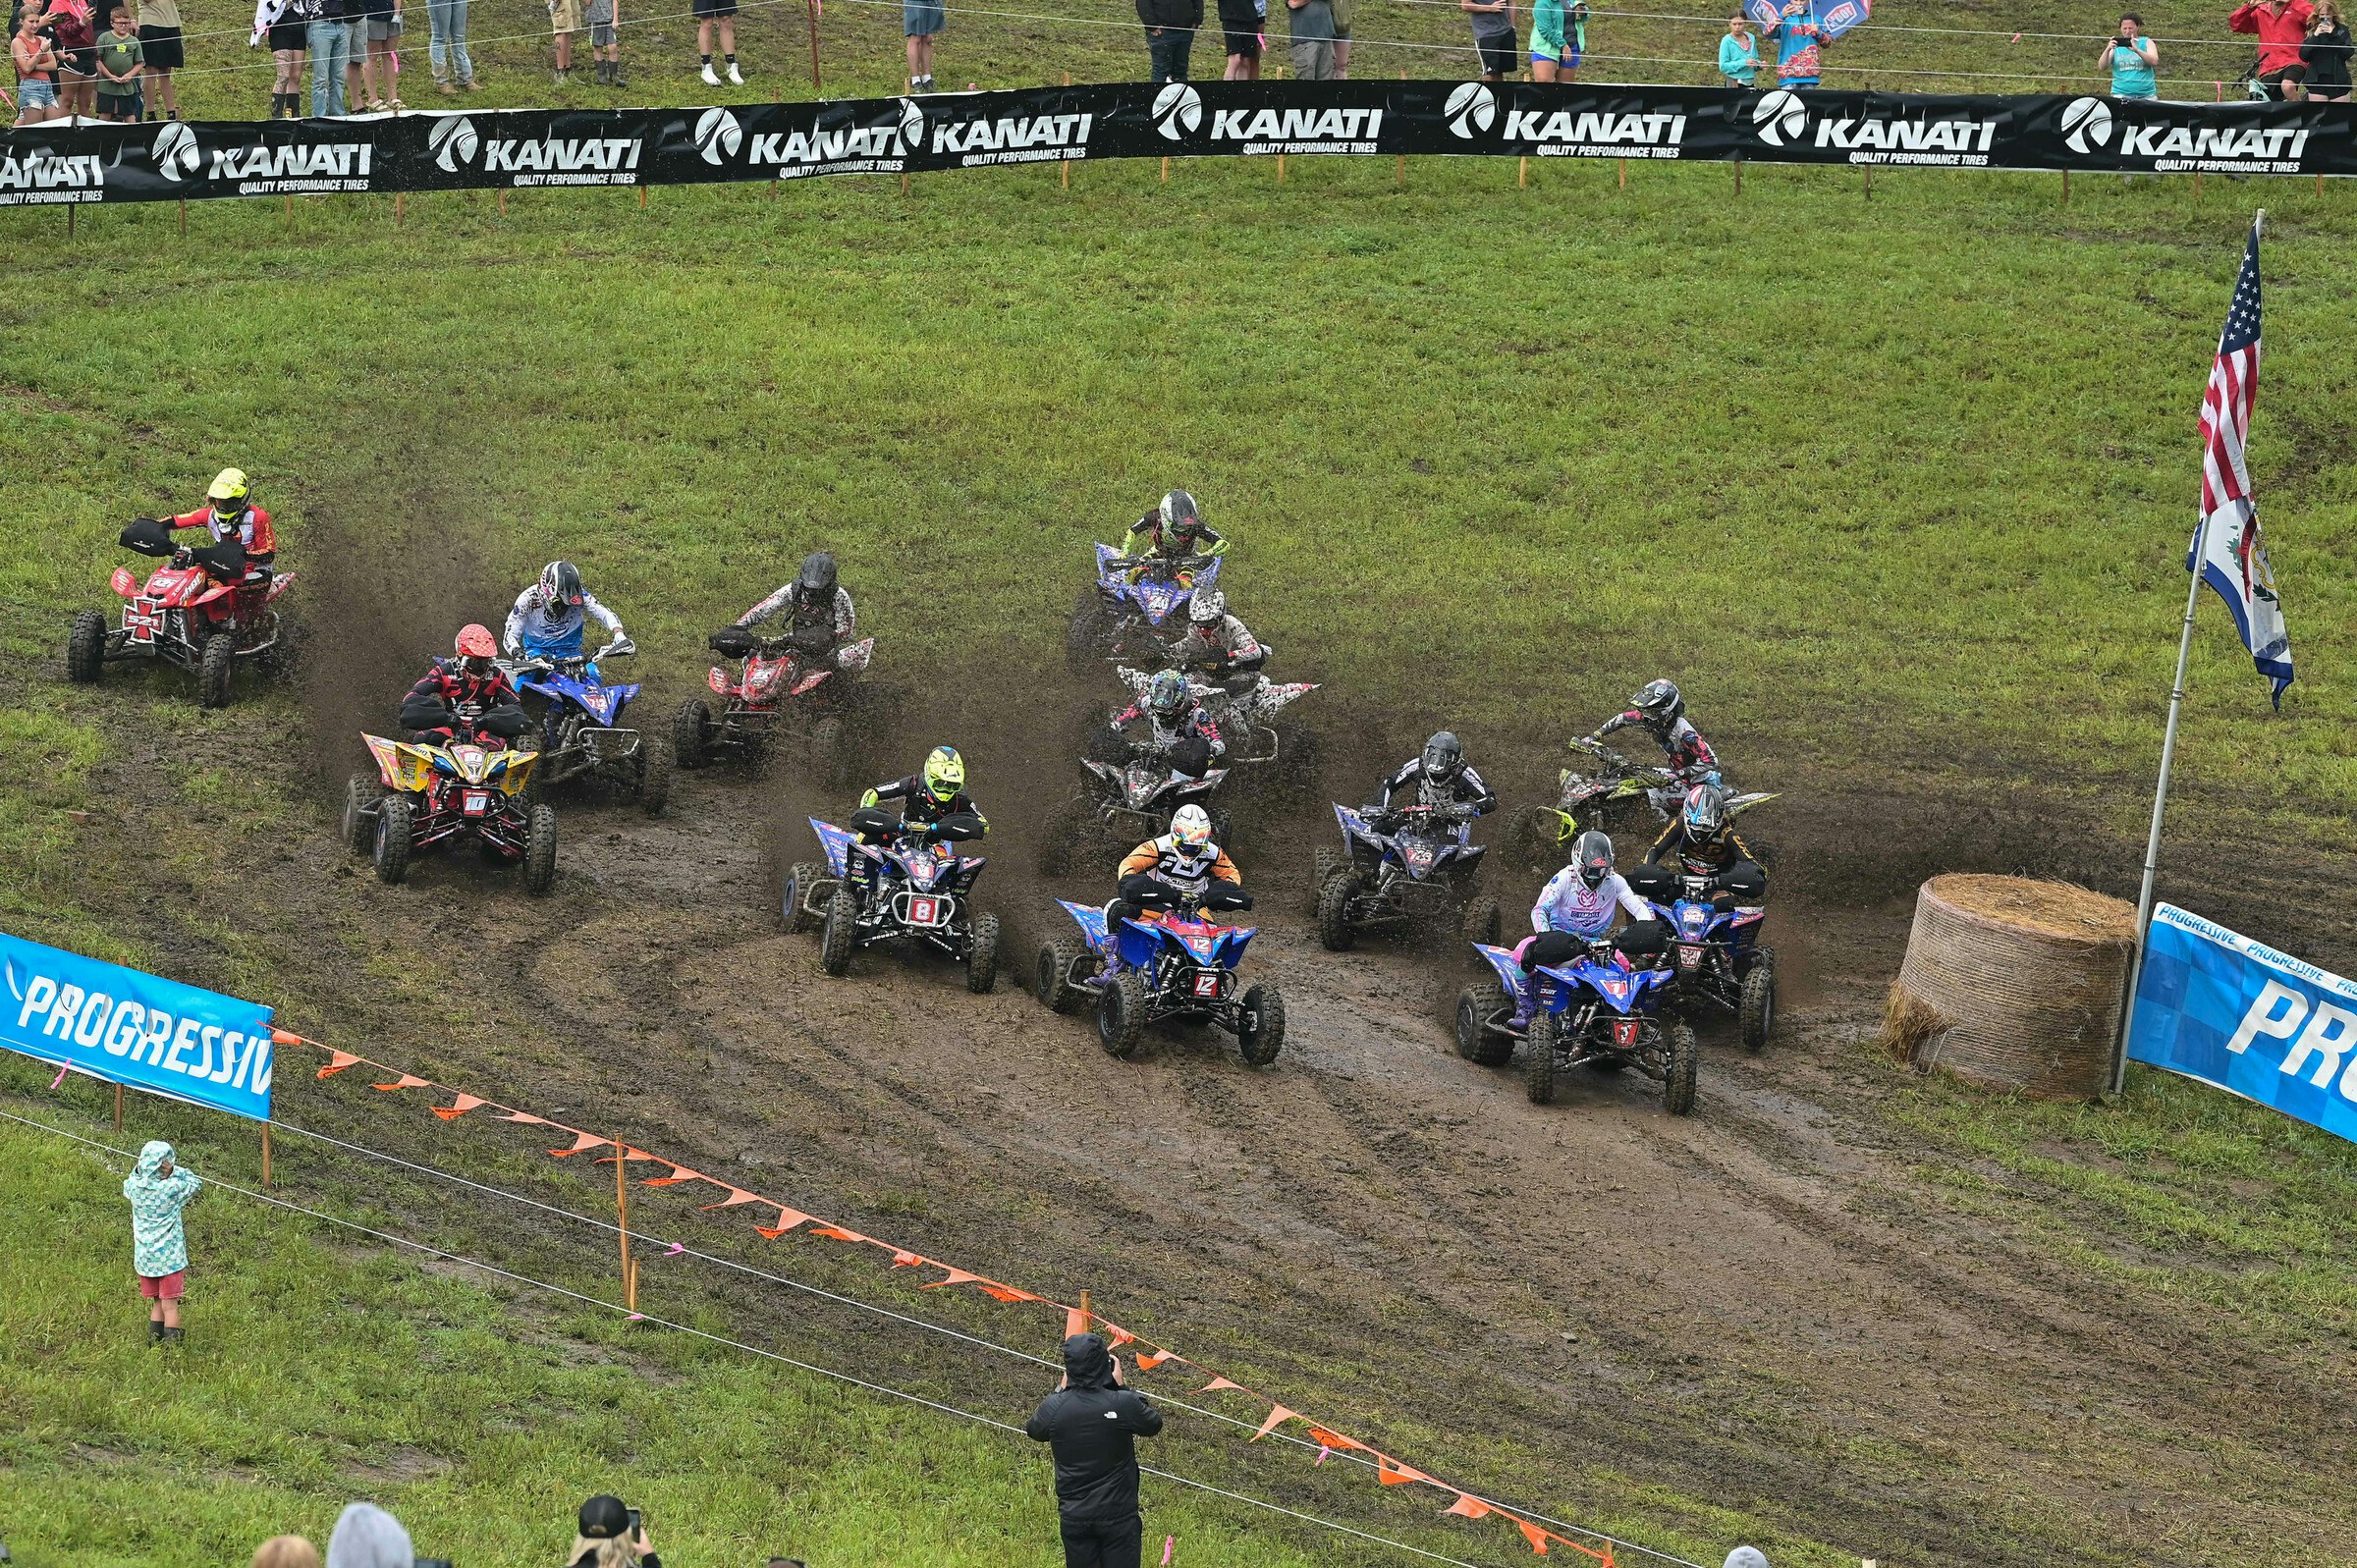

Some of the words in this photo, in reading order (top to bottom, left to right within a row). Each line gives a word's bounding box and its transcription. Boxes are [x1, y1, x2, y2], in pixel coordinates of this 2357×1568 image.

[932, 113, 1092, 153] KANATI
[1210, 108, 1383, 139] KANATI
[1503, 110, 1686, 144] KANATI
[1814, 118, 1996, 151] KANATI
[2120, 126, 2309, 158] KANATI
[485, 138, 642, 171] KANATI
[749, 126, 907, 164] KANATI
[1242, 142, 1283, 154] QUALITY
[1285, 142, 1348, 153] PERFORMANCE
[1350, 142, 1377, 153] TIRES
[1536, 144, 1576, 157] QUALITY
[1578, 145, 1650, 158] PERFORMANCE
[1652, 147, 1679, 159] TIRES
[208, 143, 371, 180] KANATI
[962, 153, 997, 166] QUALITY
[998, 149, 1062, 163] PERFORMANCE
[1063, 147, 1086, 159] TIRES
[1849, 151, 1889, 163] QUALITY
[1890, 152, 1961, 165] PERFORMANCE
[1961, 154, 1989, 166] TIRES
[2155, 159, 2196, 172] QUALITY
[2197, 160, 2272, 173] PERFORMANCE
[2273, 161, 2300, 173] TIRES
[0, 155, 103, 188] ANATI
[780, 166, 814, 179] QUALITY
[815, 162, 875, 175] PERFORMANCE
[876, 160, 904, 171] TIRES
[239, 181, 275, 194] QUALITY
[277, 180, 342, 191] PERFORMANCE
[343, 179, 369, 190] TIRES
[514, 174, 545, 186] QUALITY
[546, 173, 609, 185] PERFORMANCE
[610, 173, 636, 184] TIRES
[0, 192, 25, 204] UALITY
[26, 192, 80, 203] PERFORMANCE
[81, 189, 103, 201] TIRES
[466, 796, 487, 811] 10
[1159, 855, 1210, 878] FLY
[1167, 877, 1191, 887] ACTION
[916, 903, 931, 920] 8
[1193, 939, 1210, 950] 12
[2159, 905, 2239, 945] PROGRESSIVE
[2246, 943, 2324, 981] PROGRESSIVE
[1195, 976, 1217, 992] 12
[1612, 983, 1620, 995] 1
[18, 975, 272, 1096] PROGRESSIV
